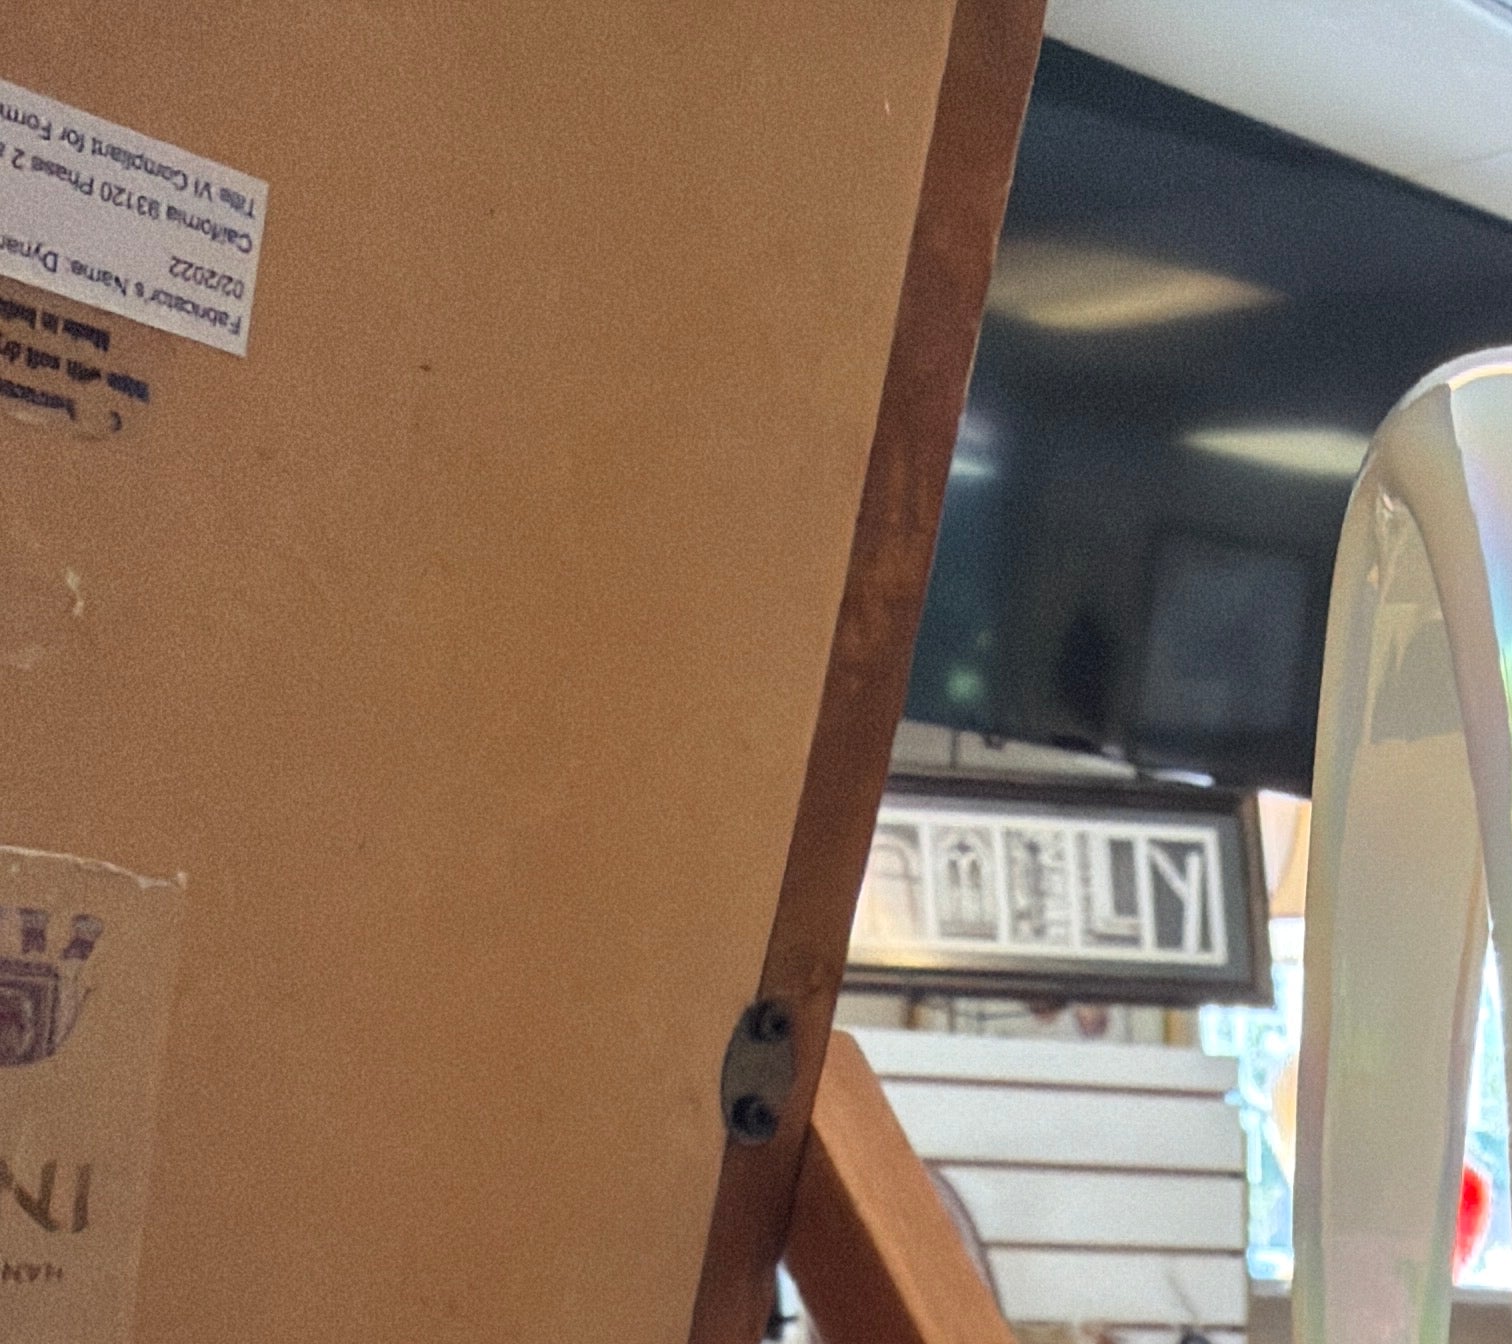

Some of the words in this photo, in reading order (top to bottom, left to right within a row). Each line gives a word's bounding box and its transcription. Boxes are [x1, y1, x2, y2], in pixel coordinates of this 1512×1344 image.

[0, 103, 52, 141] Form
[58, 127, 85, 153] for
[11, 148, 25, 170] 2
[31, 155, 95, 197] Phase
[91, 137, 189, 192] Compliant
[101, 181, 161, 220] 93120
[193, 178, 214, 202] VI
[219, 187, 255, 219] Title
[166, 205, 254, 254] California
[168, 255, 245, 300] 02/2022
[135, 281, 242, 335] Fabricator's
